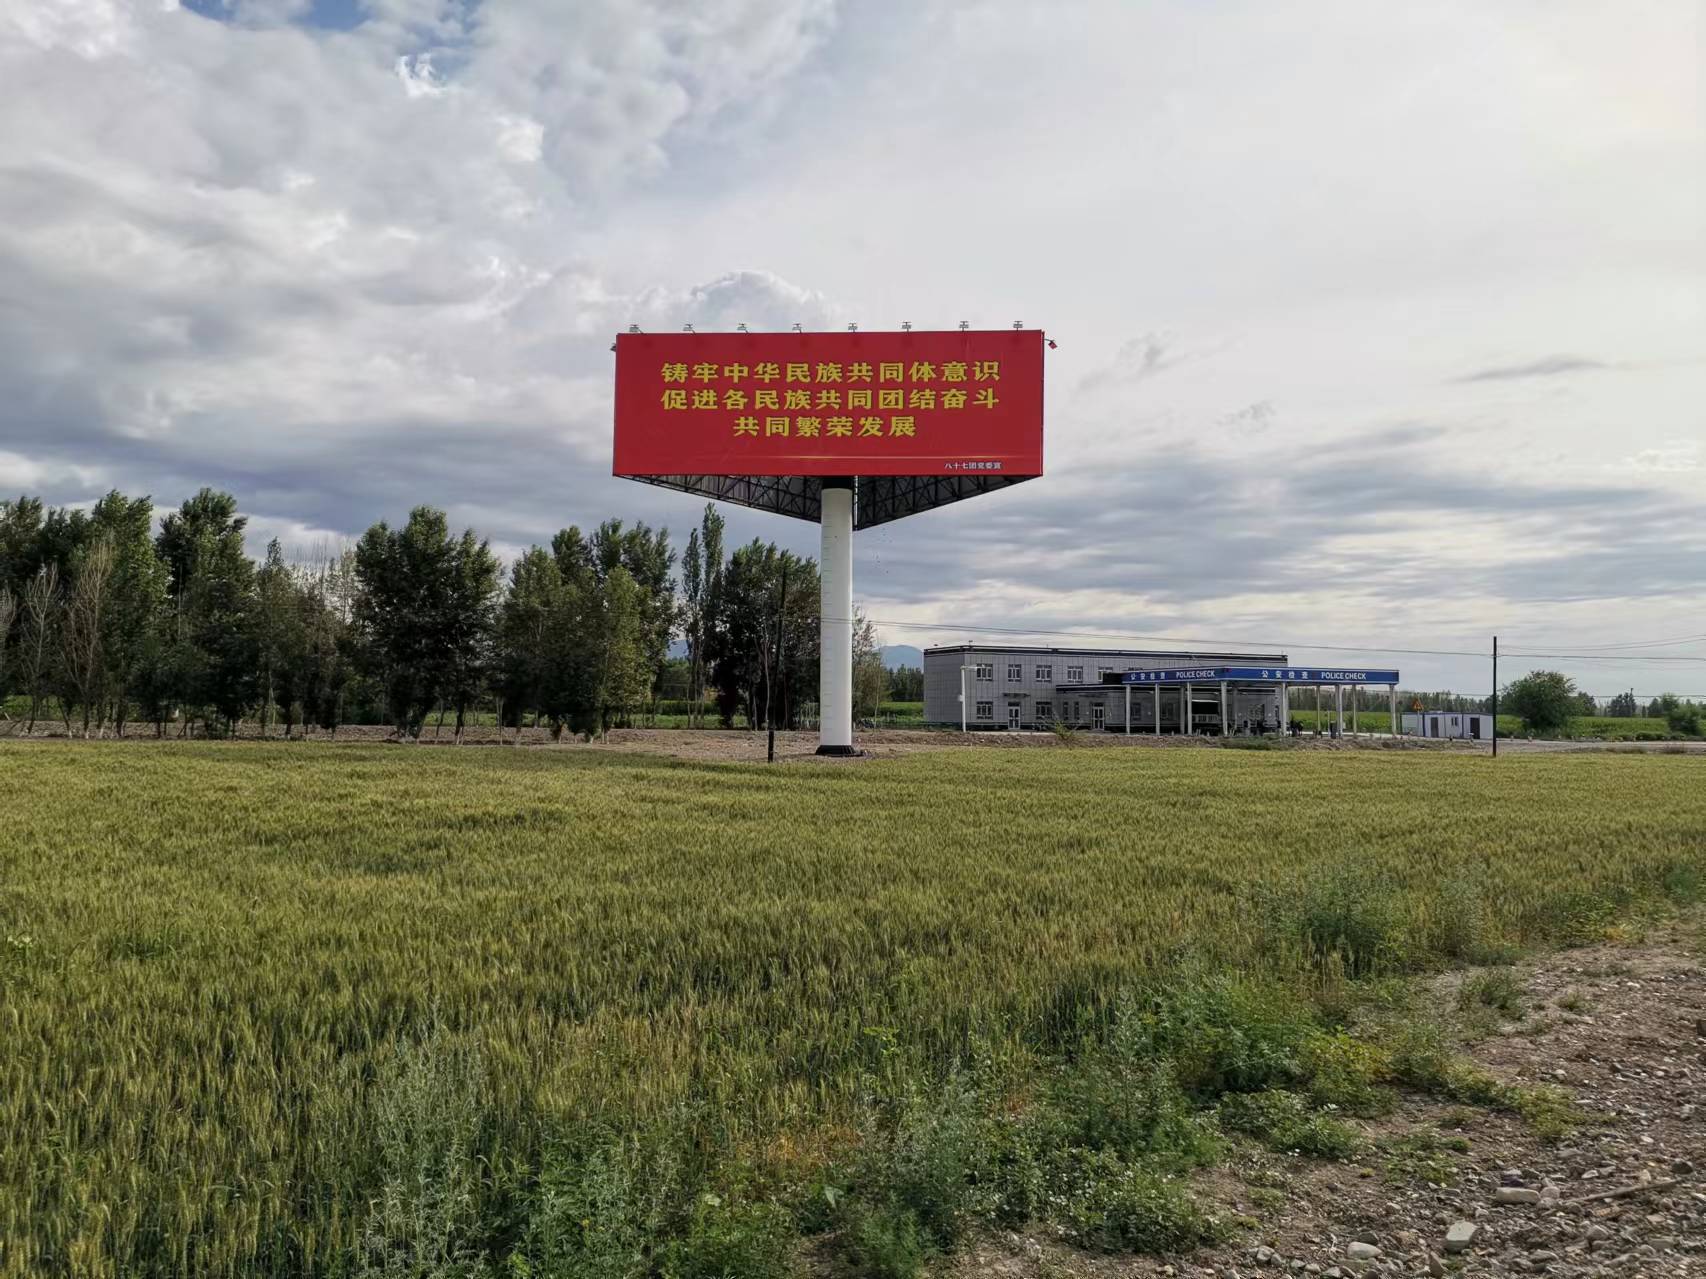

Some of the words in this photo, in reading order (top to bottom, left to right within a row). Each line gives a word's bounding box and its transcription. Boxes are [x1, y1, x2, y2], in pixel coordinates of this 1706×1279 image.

[661, 361, 1000, 383] 铸牢中华民族共同体意识
[661, 388, 999, 410] 促进各民族共同团结奋斗
[733, 416, 916, 437] 共同繁荣发展
[1175, 670, 1195, 679] POLICE
[1195, 669, 1215, 678] CHECK
[1321, 671, 1344, 680] POLICE
[1344, 671, 1367, 680] CHECK
